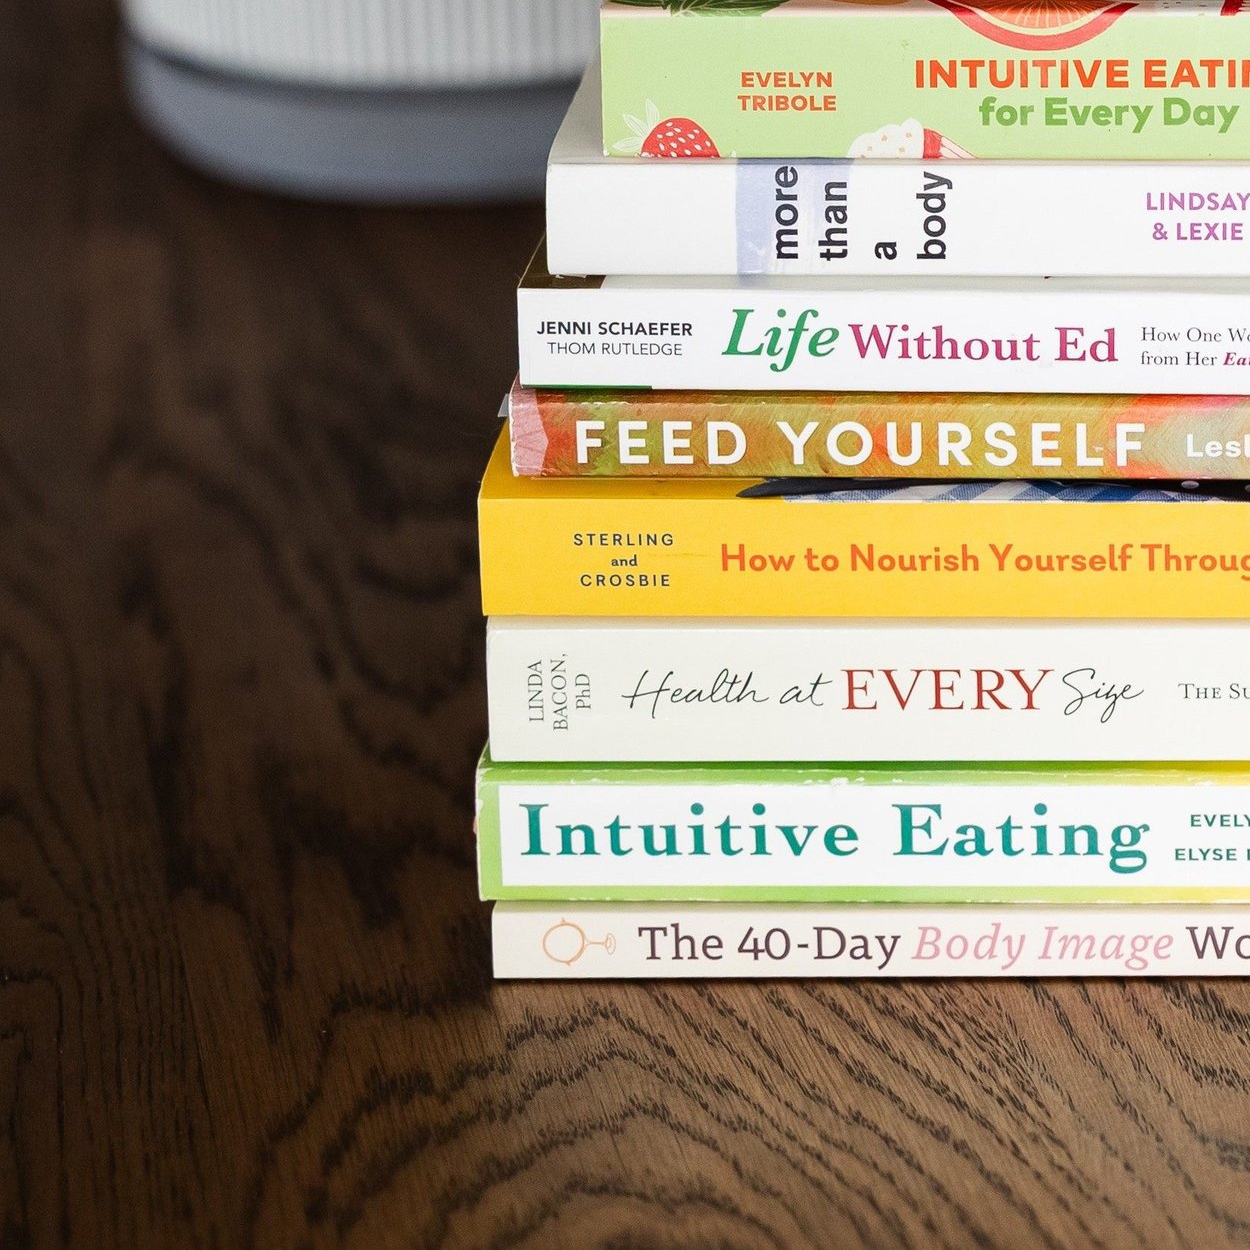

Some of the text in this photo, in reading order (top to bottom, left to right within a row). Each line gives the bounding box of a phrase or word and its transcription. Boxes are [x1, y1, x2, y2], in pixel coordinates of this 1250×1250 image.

[742, 72, 832, 87] EVELYN
[916, 60, 1129, 88] INTUITIVE
[737, 95, 836, 111] TRIBOLE
[979, 96, 1240, 133] for Every Day
[775, 166, 798, 259] more
[916, 171, 952, 259] body
[1147, 192, 1250, 211] LINDSAY
[818, 182, 848, 261] than
[1153, 223, 1168, 240] &
[1177, 223, 1243, 240] LEXIE
[874, 241, 897, 260] a
[537, 322, 692, 336] JENNI SCHAEFER
[721, 309, 1118, 372] Life Without Ed
[1142, 327, 1177, 341] How
[1187, 328, 1221, 342] One
[547, 342, 682, 355] THOM RUTLEDGE
[1142, 351, 1178, 365] from
[1186, 352, 1214, 365] Her
[575, 420, 1145, 467] FEED YOURSELF
[574, 534, 673, 546] STERLING
[611, 554, 637, 566] and
[722, 544, 795, 572] How
[804, 548, 839, 572] to
[850, 544, 979, 572] Nourish
[988, 544, 1133, 572] Yourself
[580, 574, 669, 586] CROSBIE
[527, 660, 544, 722] LINDA
[550, 653, 568, 731] BACON,
[574, 673, 592, 709] PhD
[622, 668, 1144, 723] Health at EVERY Size
[519, 803, 1150, 874] Intuitive Eating
[1175, 848, 1237, 861] ELYSE
[638, 923, 723, 960] The
[738, 927, 901, 970] 40-Day
[911, 923, 1025, 970] Body
[1038, 926, 1173, 971] Image
